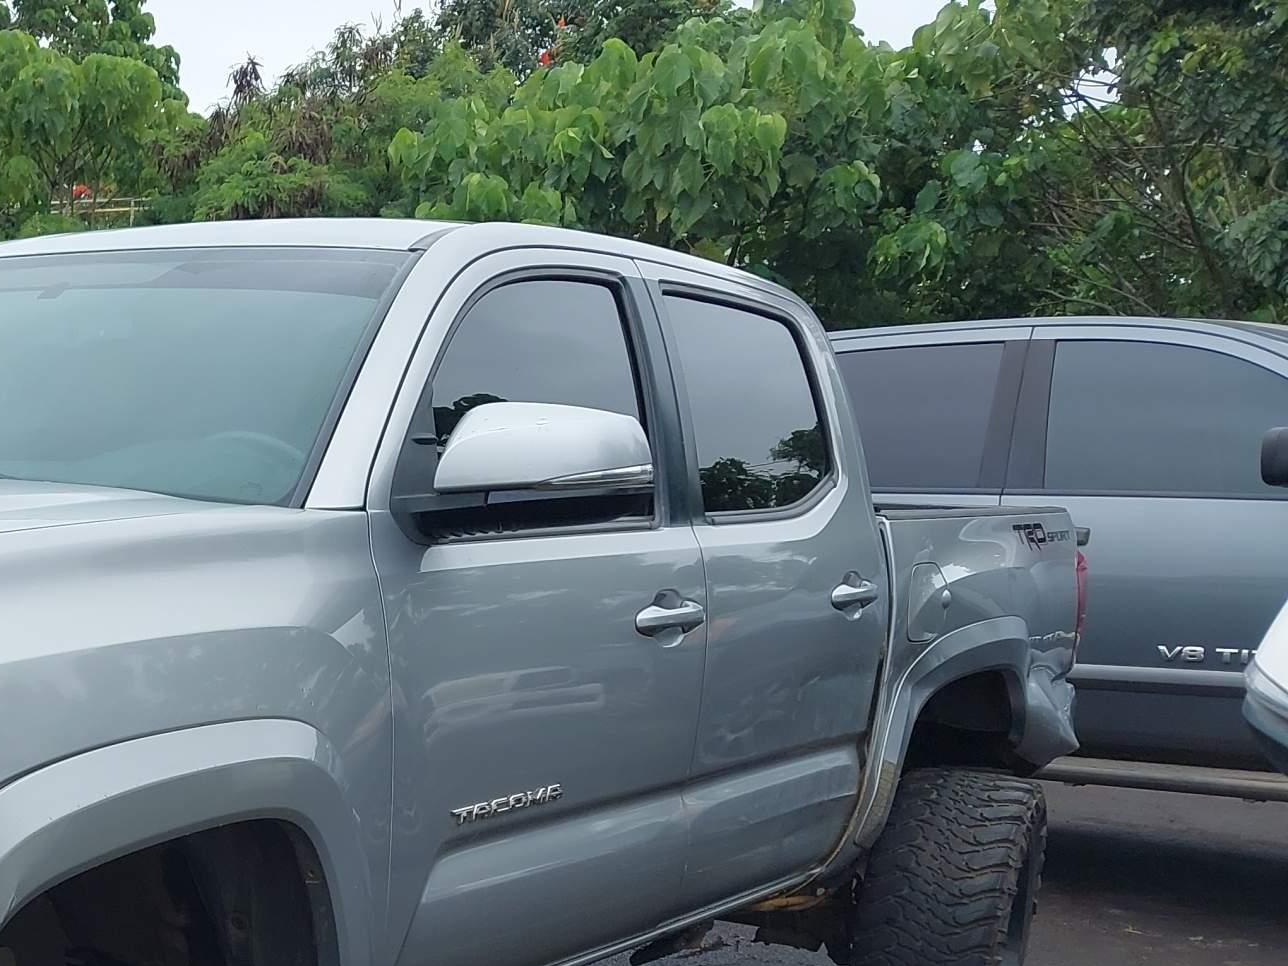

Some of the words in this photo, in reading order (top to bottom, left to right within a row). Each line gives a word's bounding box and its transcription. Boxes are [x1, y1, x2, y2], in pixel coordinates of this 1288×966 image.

[1012, 523, 1047, 551] TRD
[1047, 530, 1071, 542] SPORT
[1157, 645, 1205, 662] V8
[1215, 648, 1258, 664] TI
[450, 783, 563, 824] TACOMA
